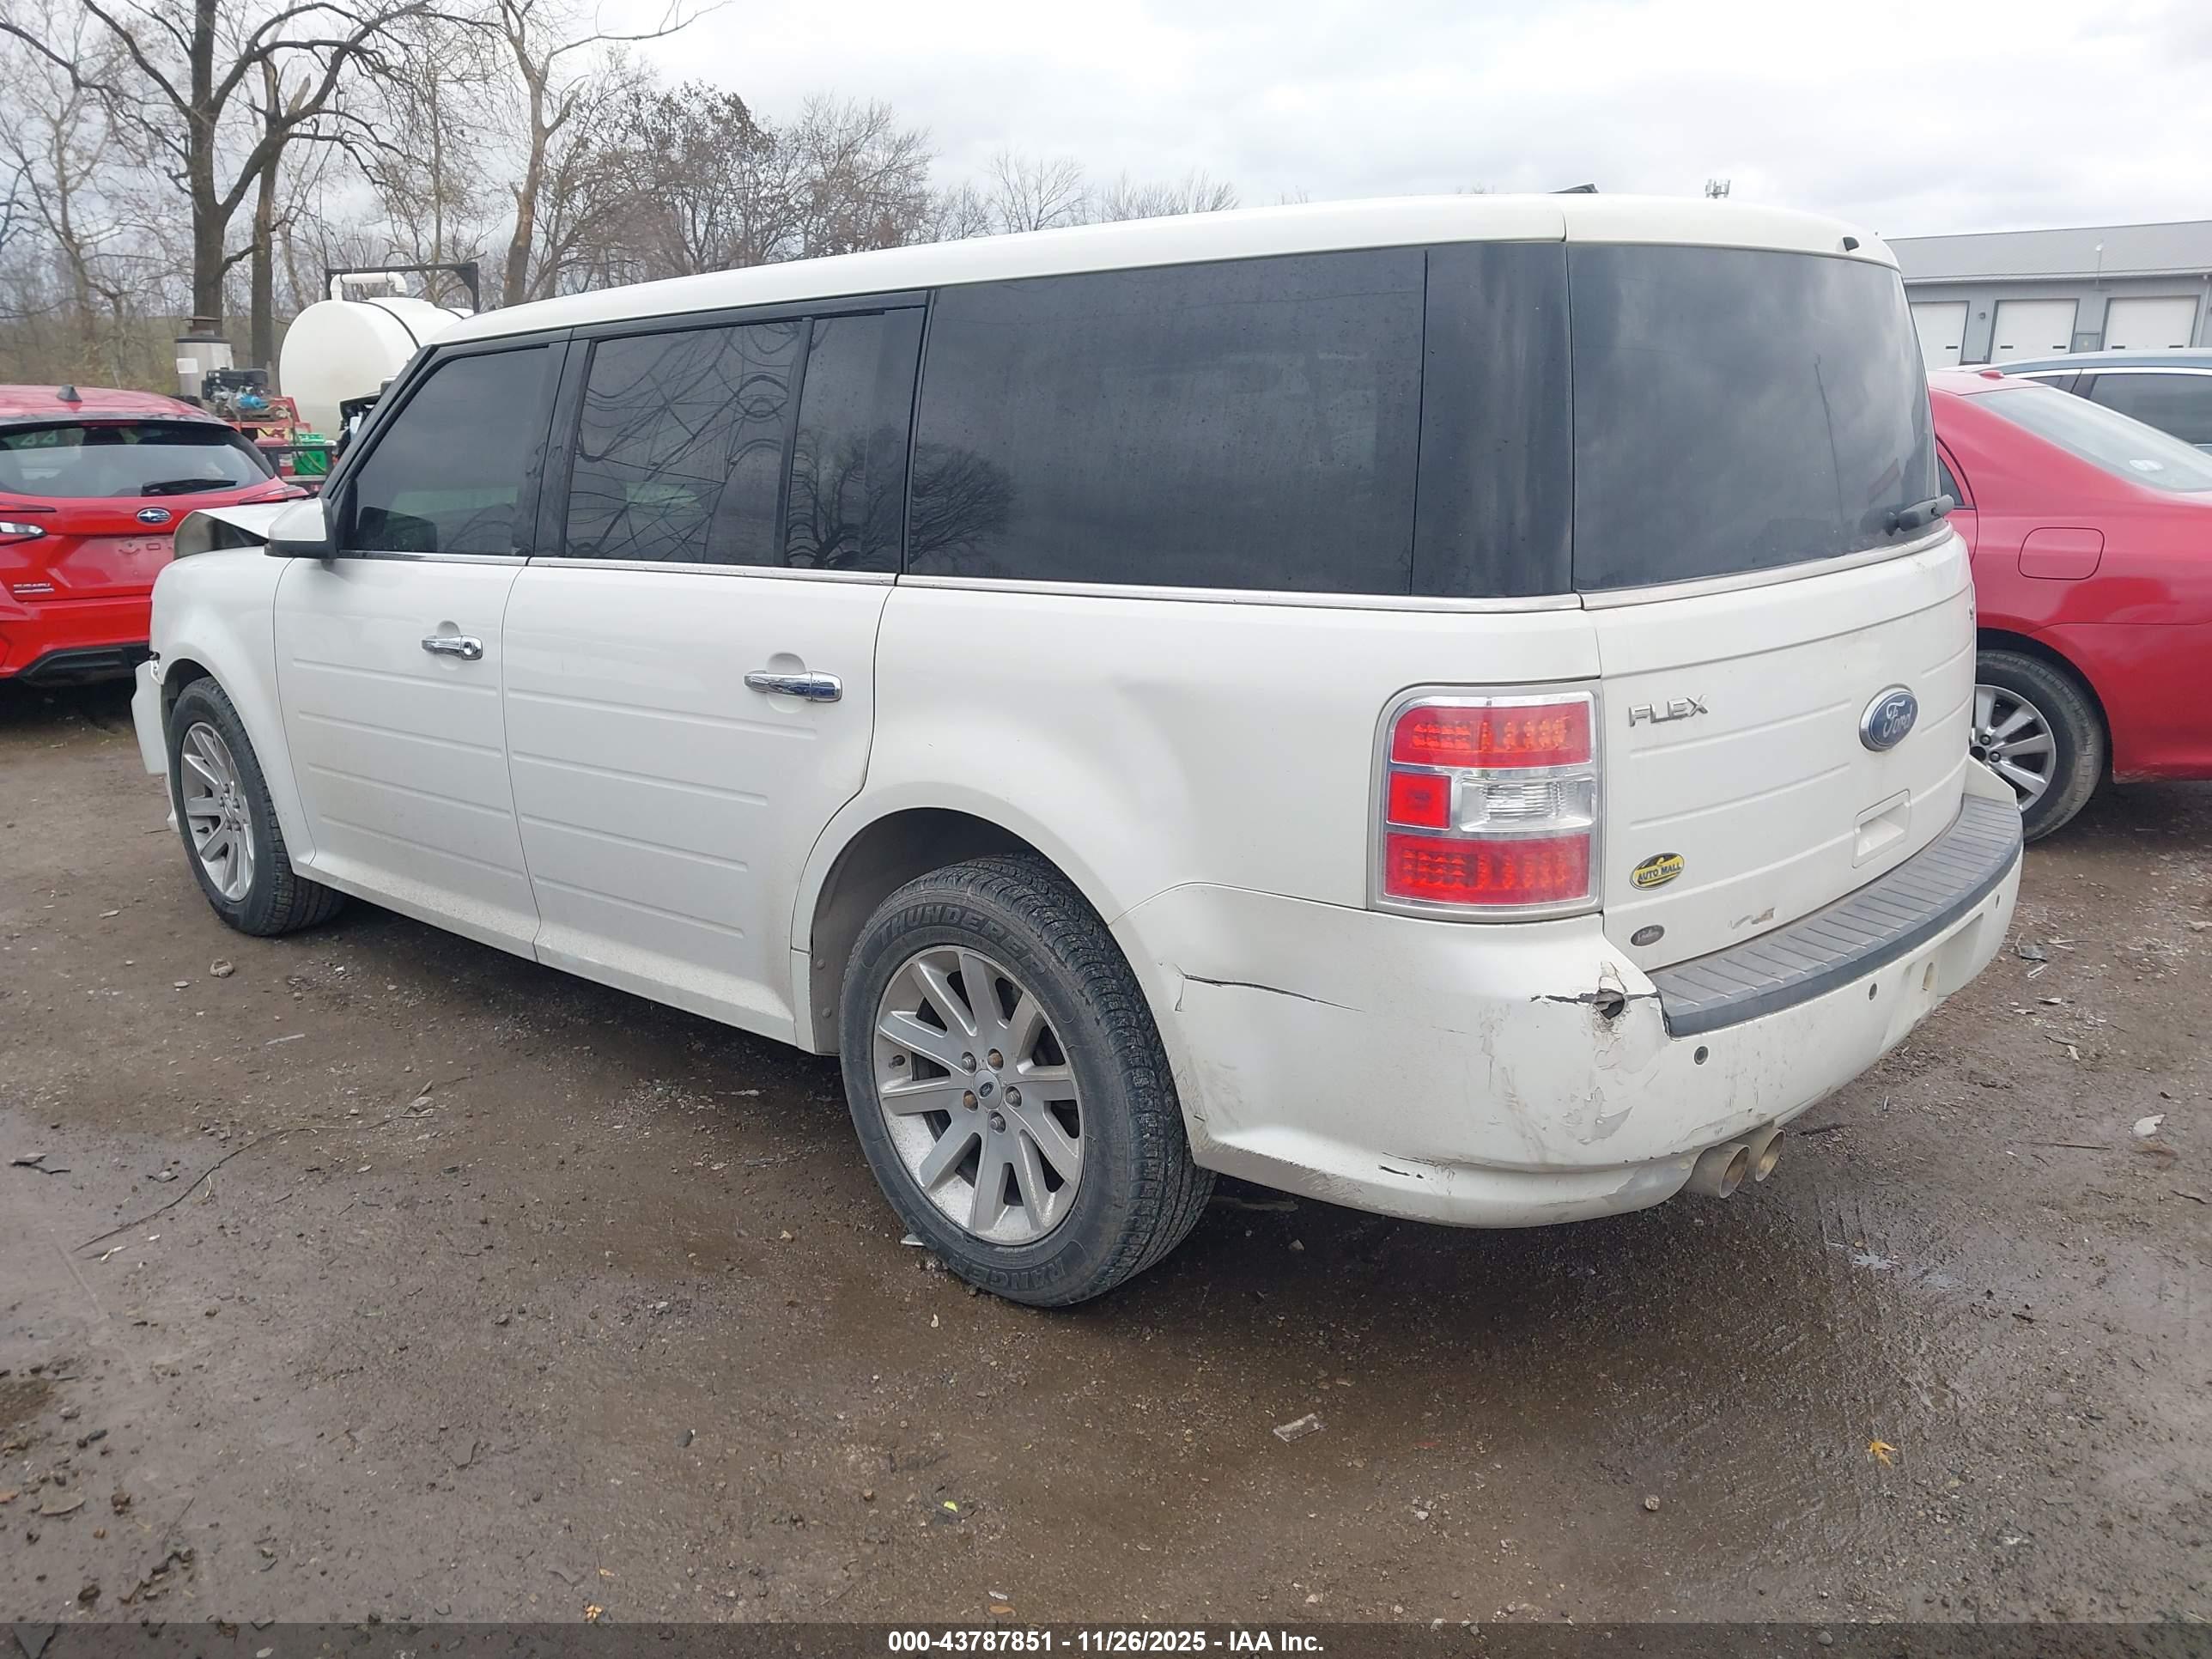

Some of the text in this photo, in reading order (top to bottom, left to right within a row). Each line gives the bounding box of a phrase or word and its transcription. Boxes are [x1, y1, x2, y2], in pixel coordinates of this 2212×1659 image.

[1628, 693, 1709, 727] FLEX
[1882, 700, 1913, 738] Ford
[1638, 862, 1681, 882] AUTO MALL
[877, 905, 1046, 976] THUNDERER
